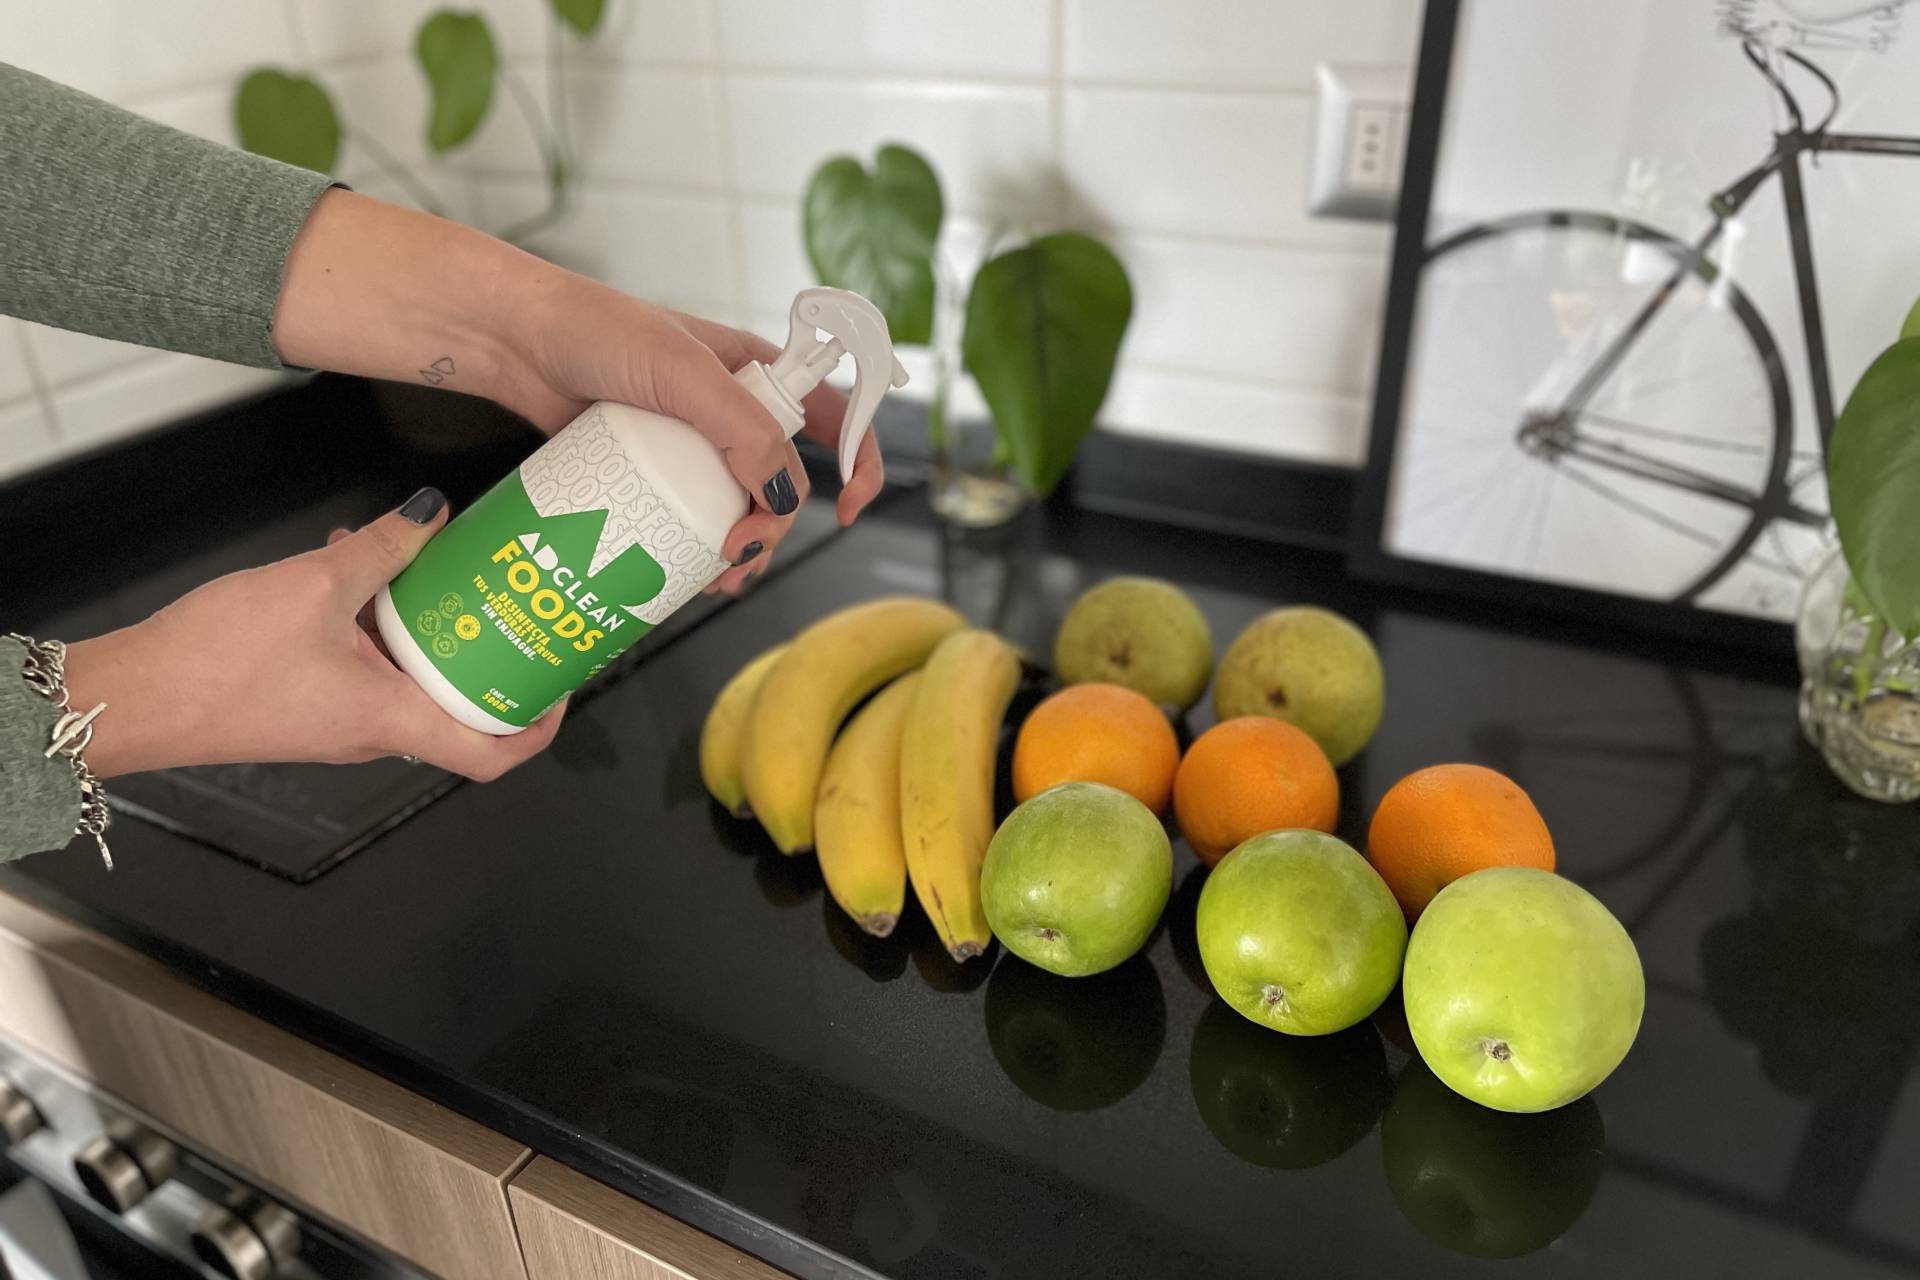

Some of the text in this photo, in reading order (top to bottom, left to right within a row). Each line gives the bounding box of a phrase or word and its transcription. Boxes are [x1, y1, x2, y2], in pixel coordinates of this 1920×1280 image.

[473, 575, 489, 593] TUS
[486, 592, 527, 637] VERDURAS
[526, 635, 535, 644] Y
[533, 642, 563, 666] FRUTAS
[491, 540, 605, 652] FOODS
[498, 592, 551, 646] DESINFECTA
[518, 533, 626, 632] ADCLEAN
[481, 603, 536, 660] SIN ENJUAGUE.
